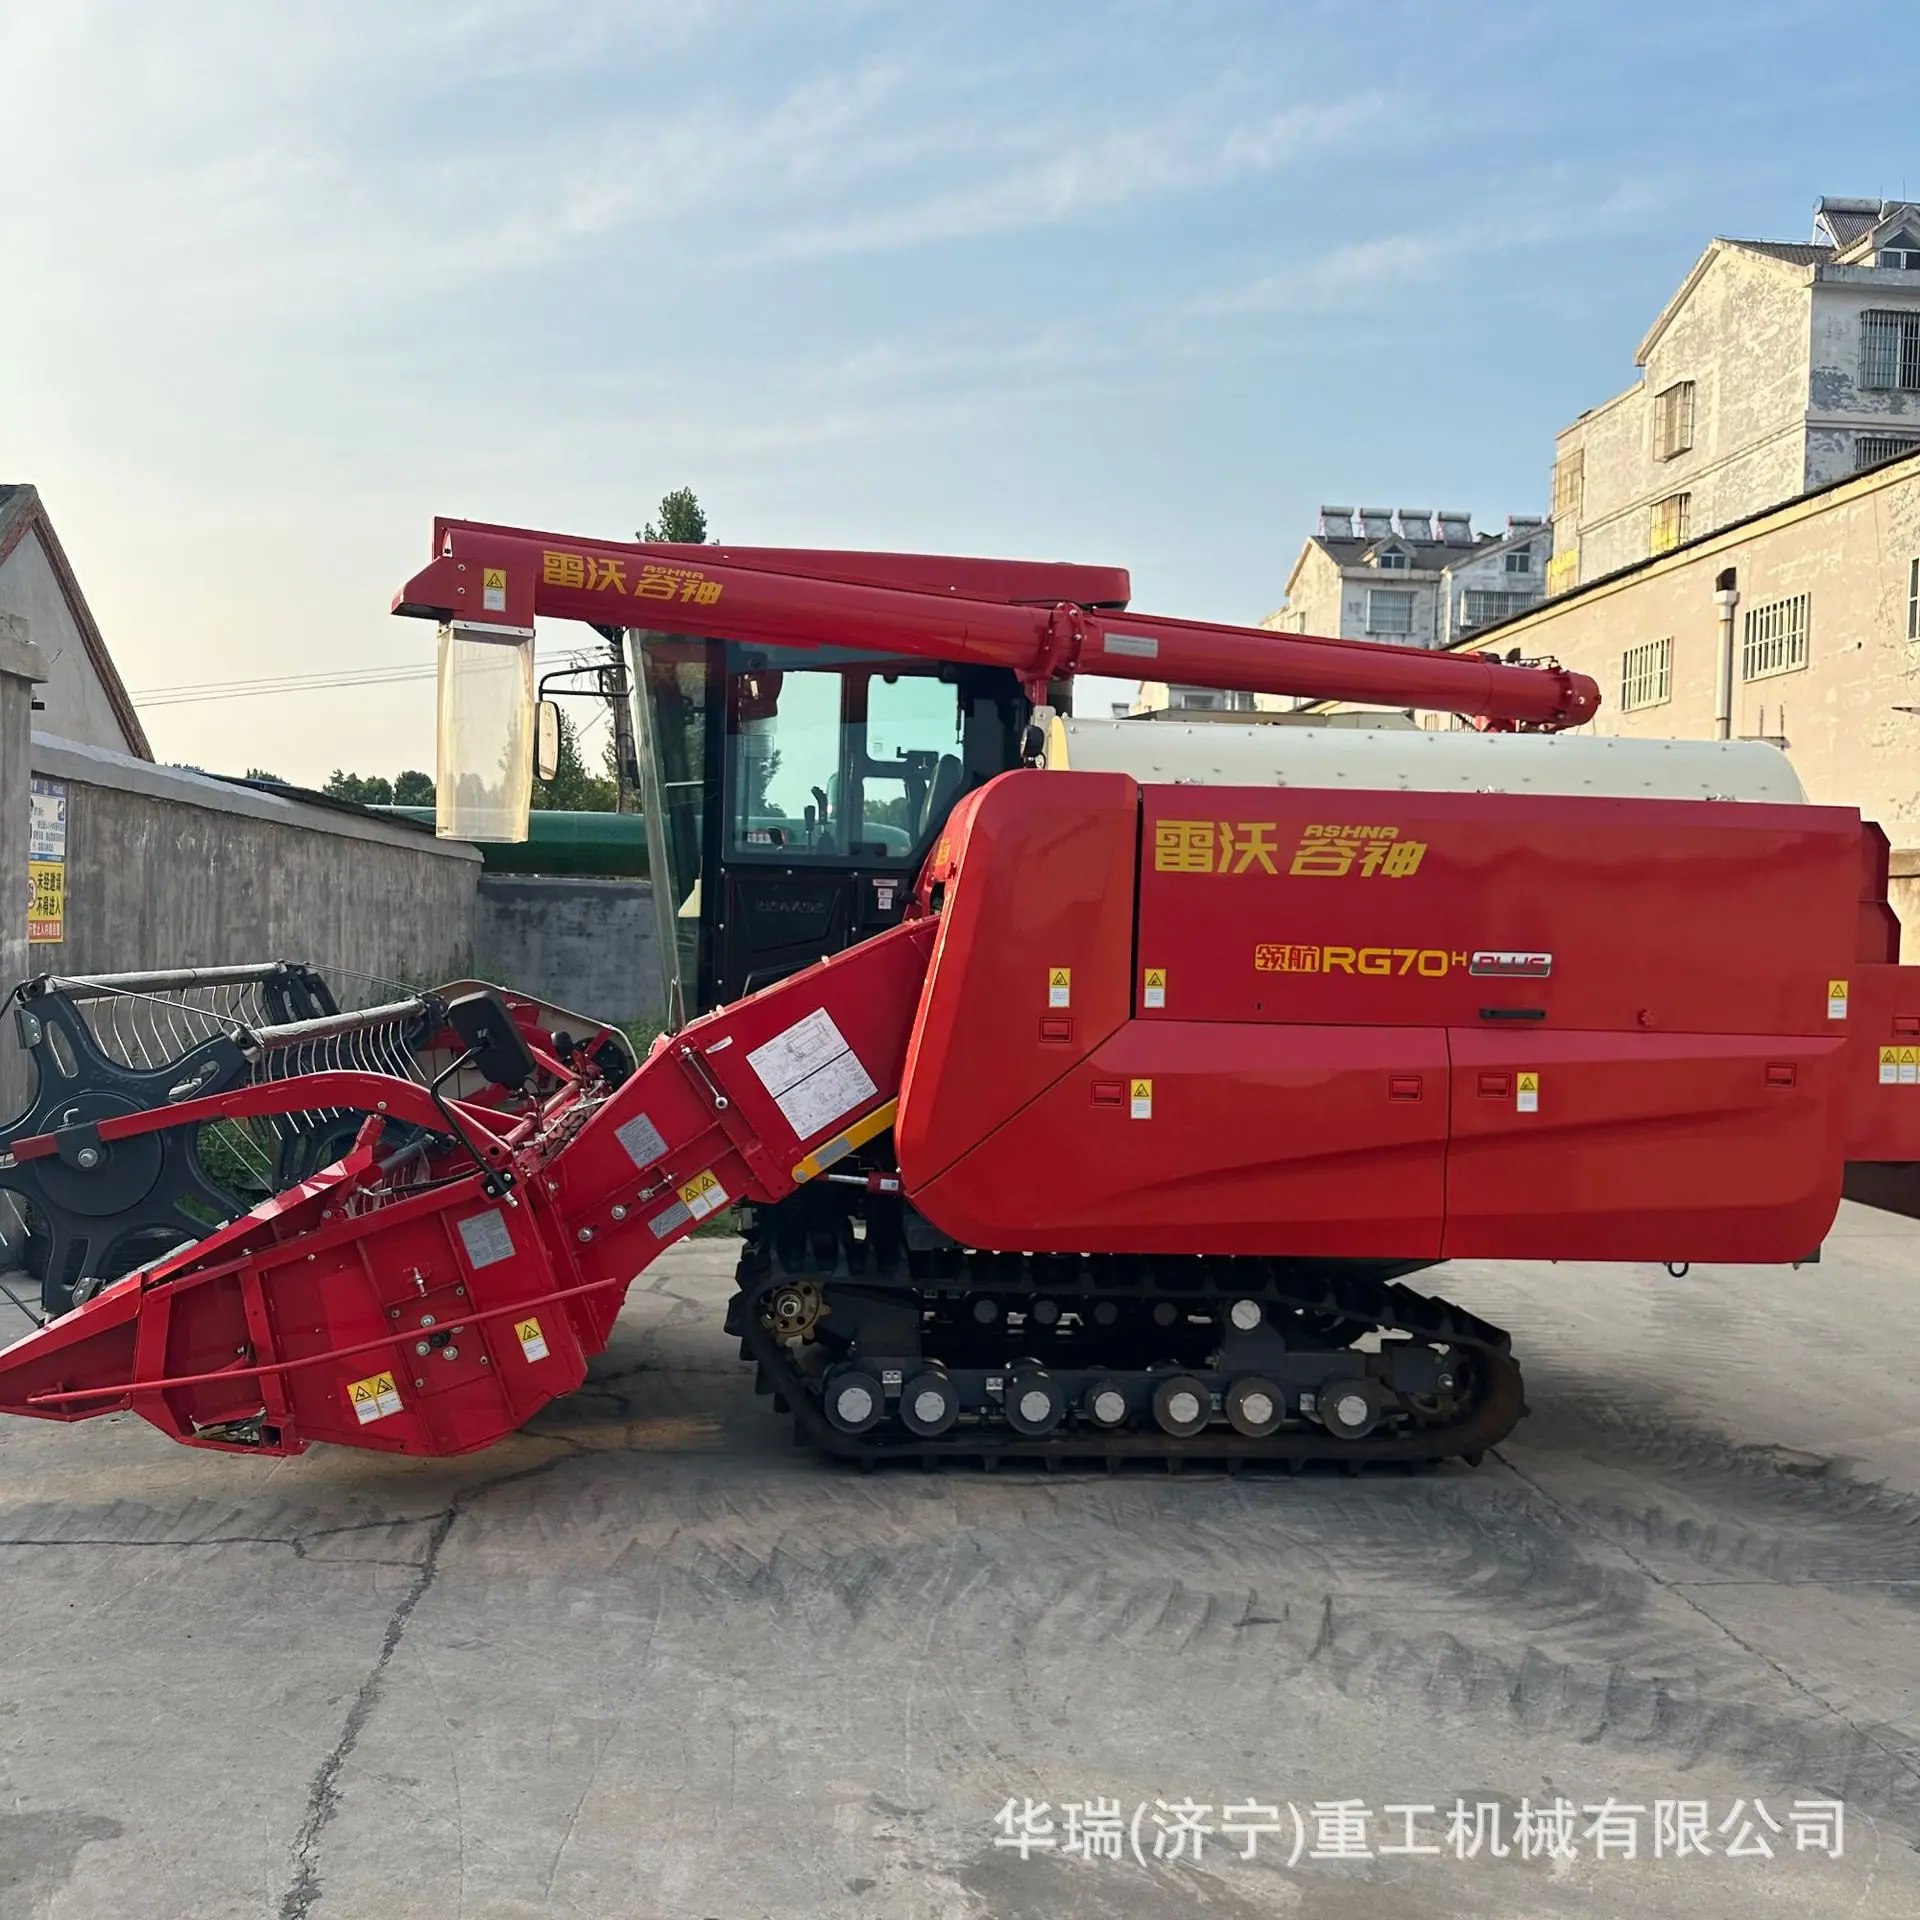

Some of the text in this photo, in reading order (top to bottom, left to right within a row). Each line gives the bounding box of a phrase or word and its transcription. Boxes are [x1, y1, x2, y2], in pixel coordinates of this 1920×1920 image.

[543, 550, 724, 605] 雷沃 谷神
[1155, 820, 1427, 878] 雷沃 谷神
[1255, 944, 1320, 972] 领航
